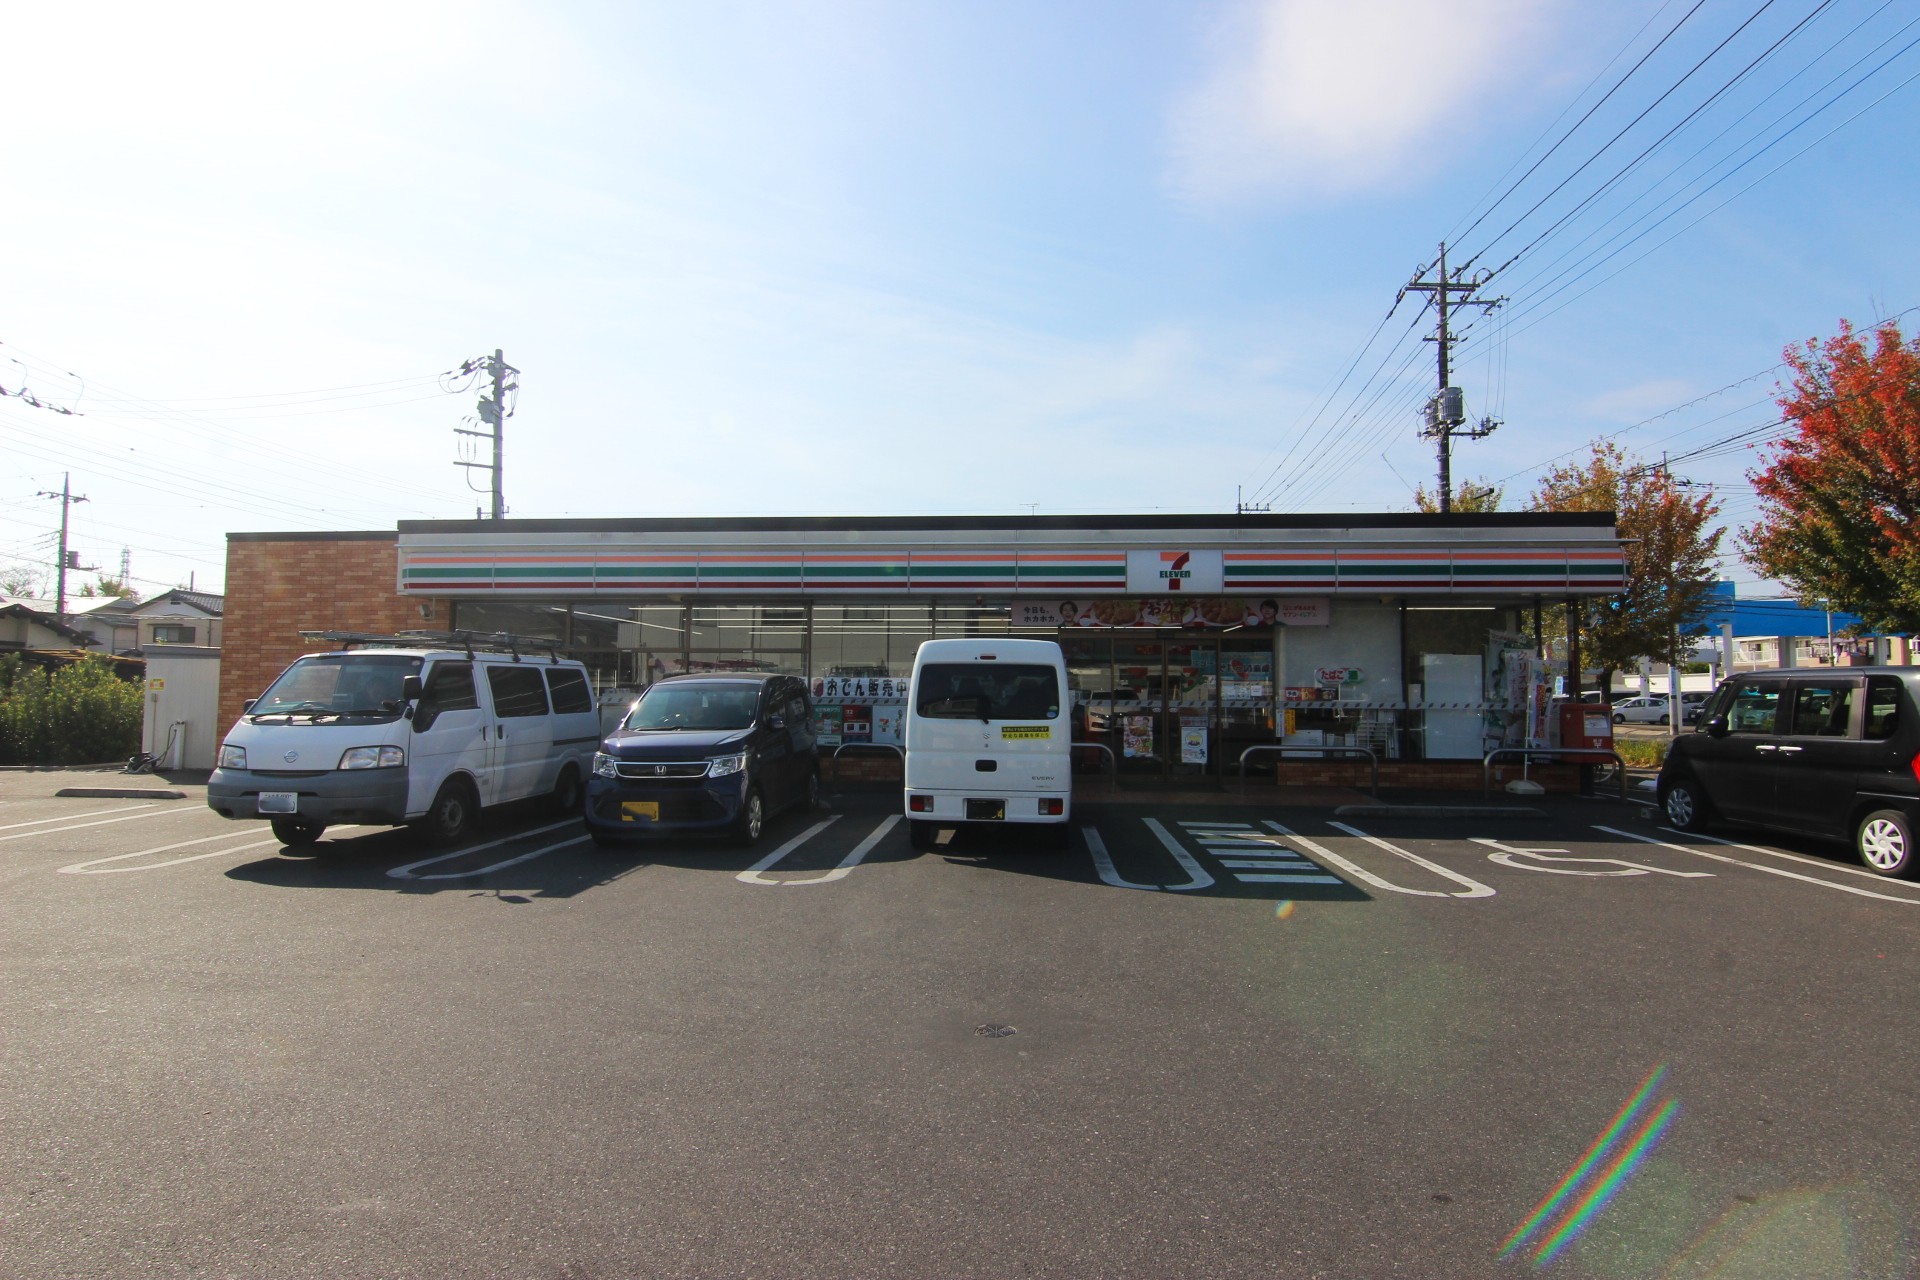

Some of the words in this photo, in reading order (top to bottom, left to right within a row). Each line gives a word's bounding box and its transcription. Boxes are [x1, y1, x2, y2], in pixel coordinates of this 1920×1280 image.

[1160, 552, 1189, 590] 7
[1321, 670, 1344, 680] たばこ
[827, 679, 907, 697] おでん販売中
